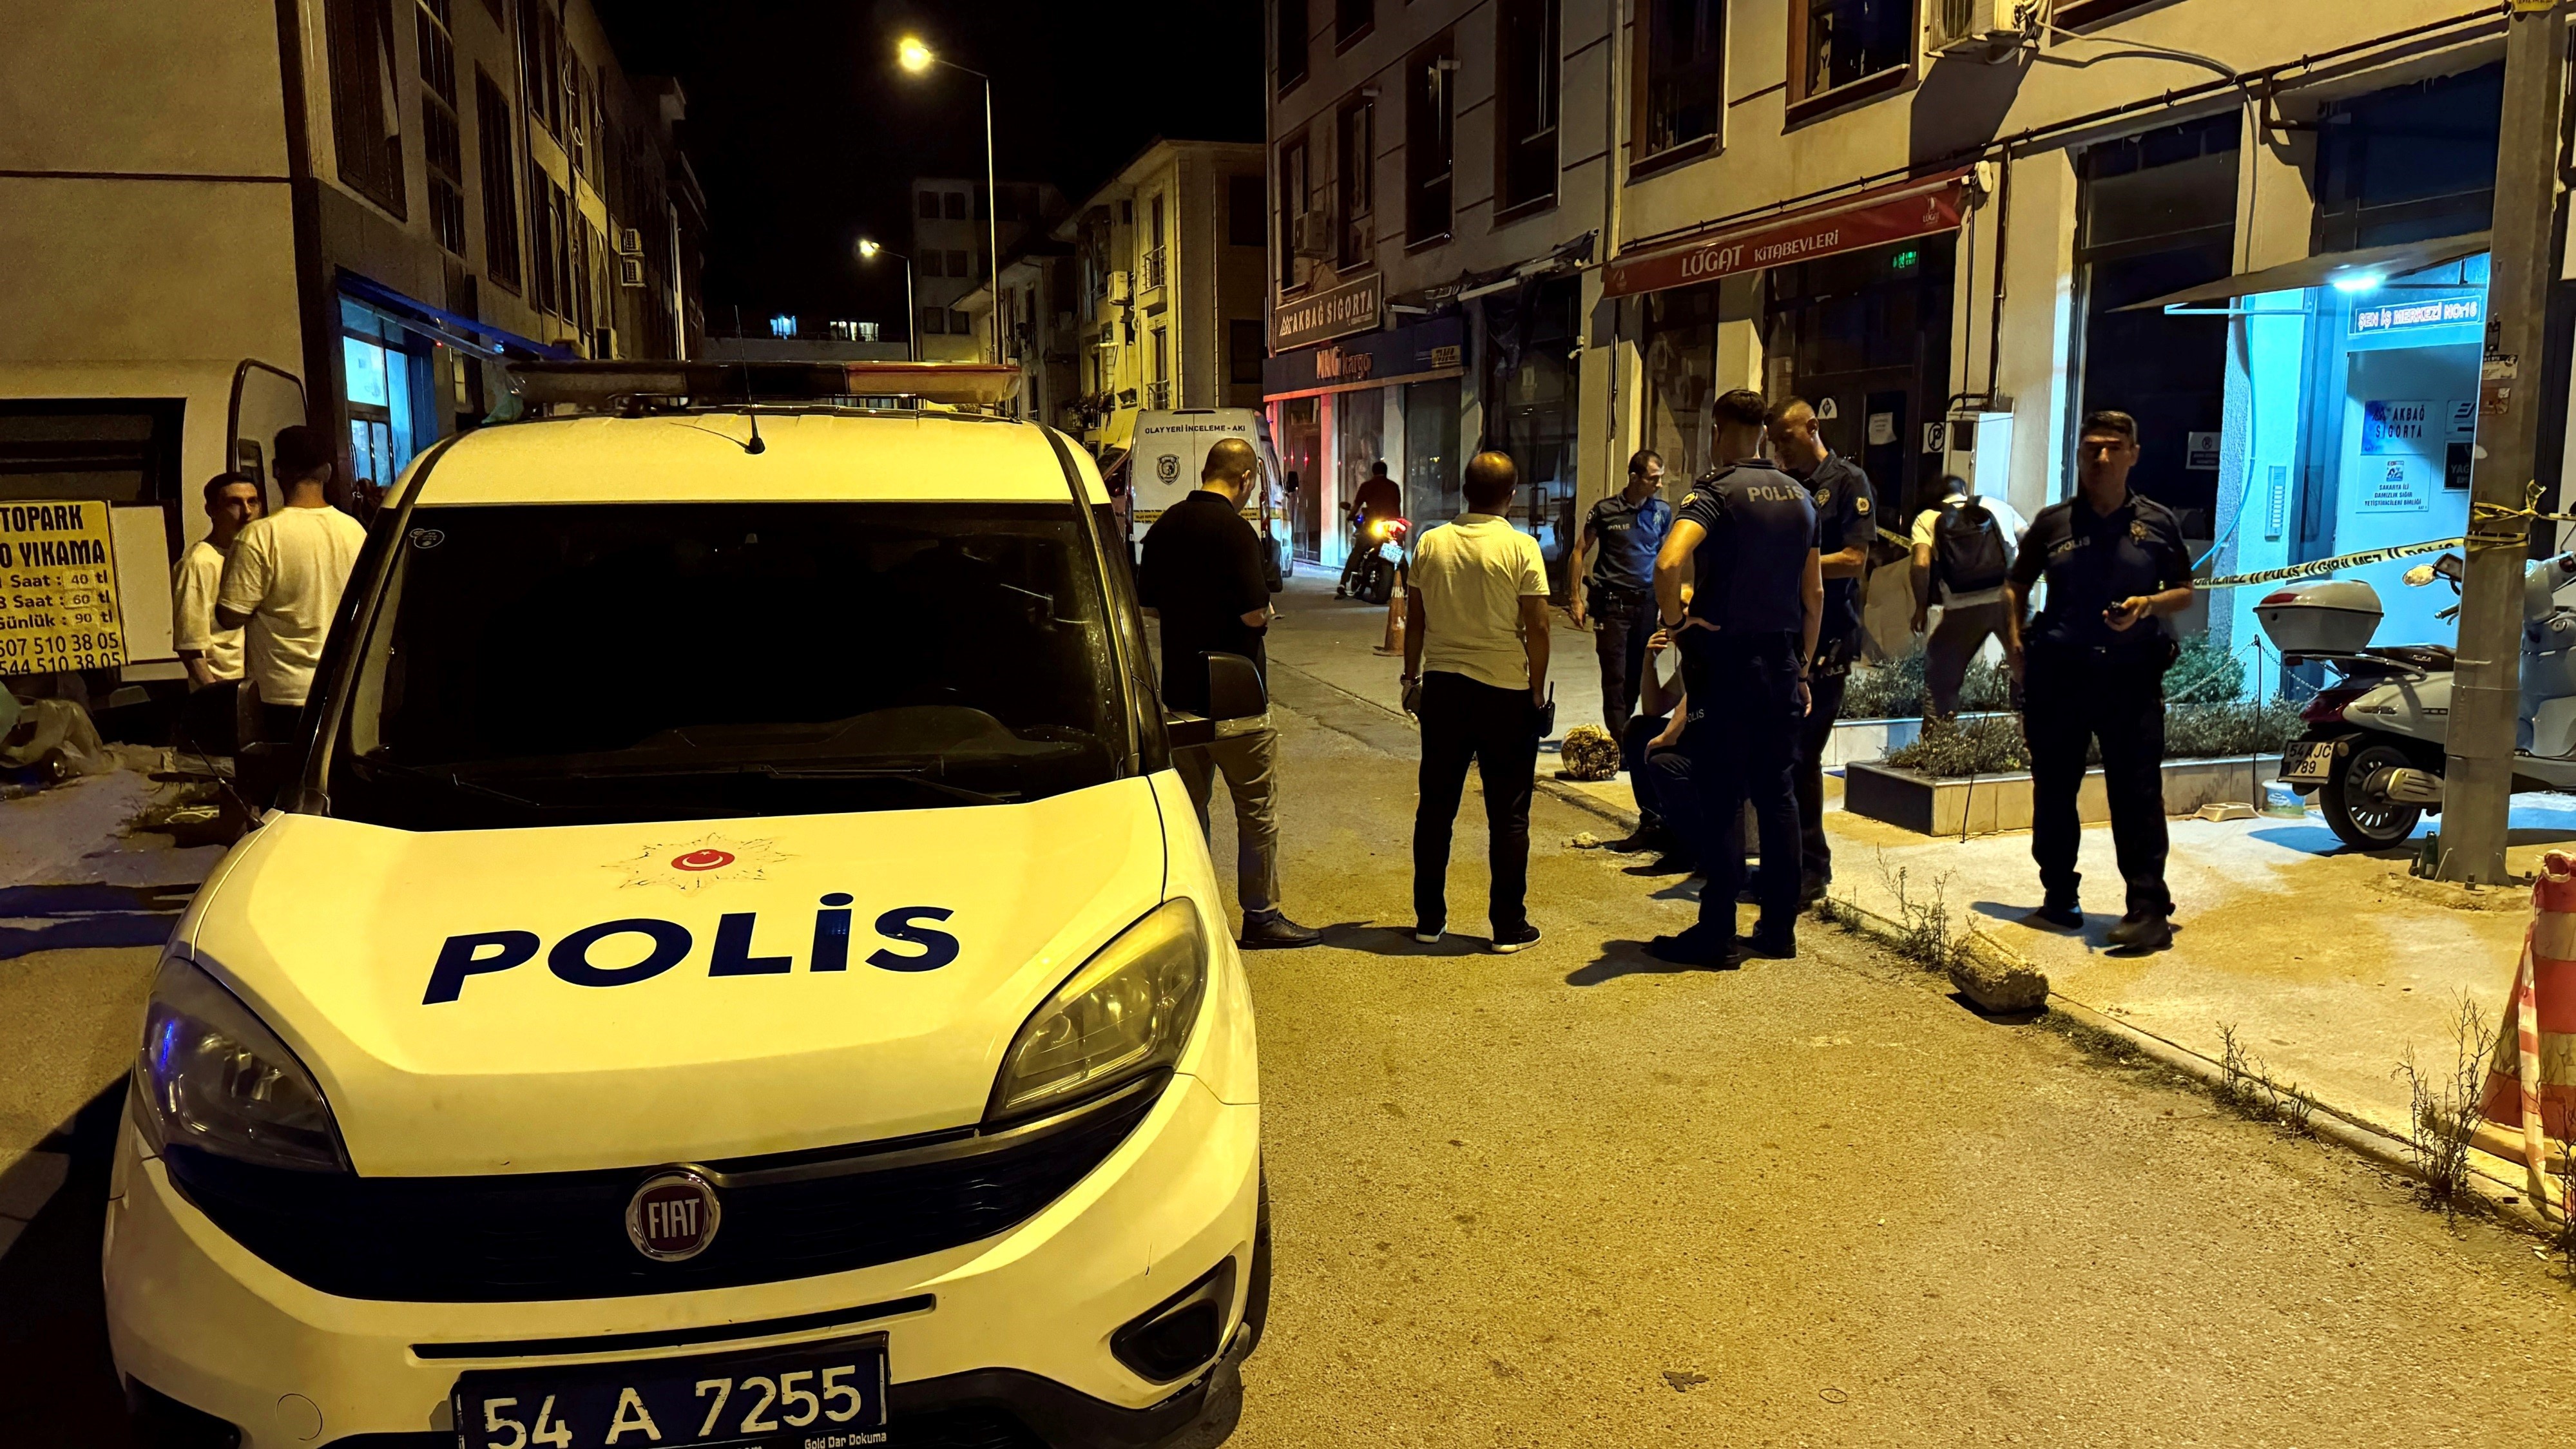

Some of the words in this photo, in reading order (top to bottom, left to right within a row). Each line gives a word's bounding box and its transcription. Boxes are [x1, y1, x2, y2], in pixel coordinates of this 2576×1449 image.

[1754, 229, 1839, 262] KİTABEVLERİ
[1293, 300, 1324, 332] AKBAĞ
[1327, 289, 1373, 324] SİGORTA
[2358, 312, 2379, 331] ŞEN
[2380, 308, 2392, 329] İŞ
[2393, 302, 2443, 325] MERKEZİ
[2392, 405, 2425, 421] AKBAĞ
[1166, 425, 1184, 433] YERİ
[1747, 485, 1805, 503] POLİS
[18, 539, 106, 567] YIKAMA
[10, 575, 51, 588] Saat
[72, 574, 88, 584] 40
[95, 570, 108, 584] tl
[13, 595, 53, 608] Saat
[73, 594, 90, 604] 60
[98, 590, 110, 603] tl
[75, 613, 92, 624] 90
[101, 609, 113, 623] tl
[34, 635, 66, 655] 510
[71, 633, 93, 652] 38
[97, 632, 119, 649] 05
[37, 655, 69, 673] 510
[74, 653, 95, 670] 38
[101, 651, 121, 667] 05
[2289, 744, 2305, 757] 54
[2294, 760, 2316, 774] 789
[423, 892, 960, 1005] POLİS
[648, 1198, 700, 1238] FIAT
[483, 1394, 573, 1449] 54
[605, 1388, 662, 1444] A
[695, 1365, 862, 1437] 7255
[805, 1437, 826, 1449] Gold
[828, 1437, 847, 1448] Dar
[849, 1432, 887, 1446] Dokuma
